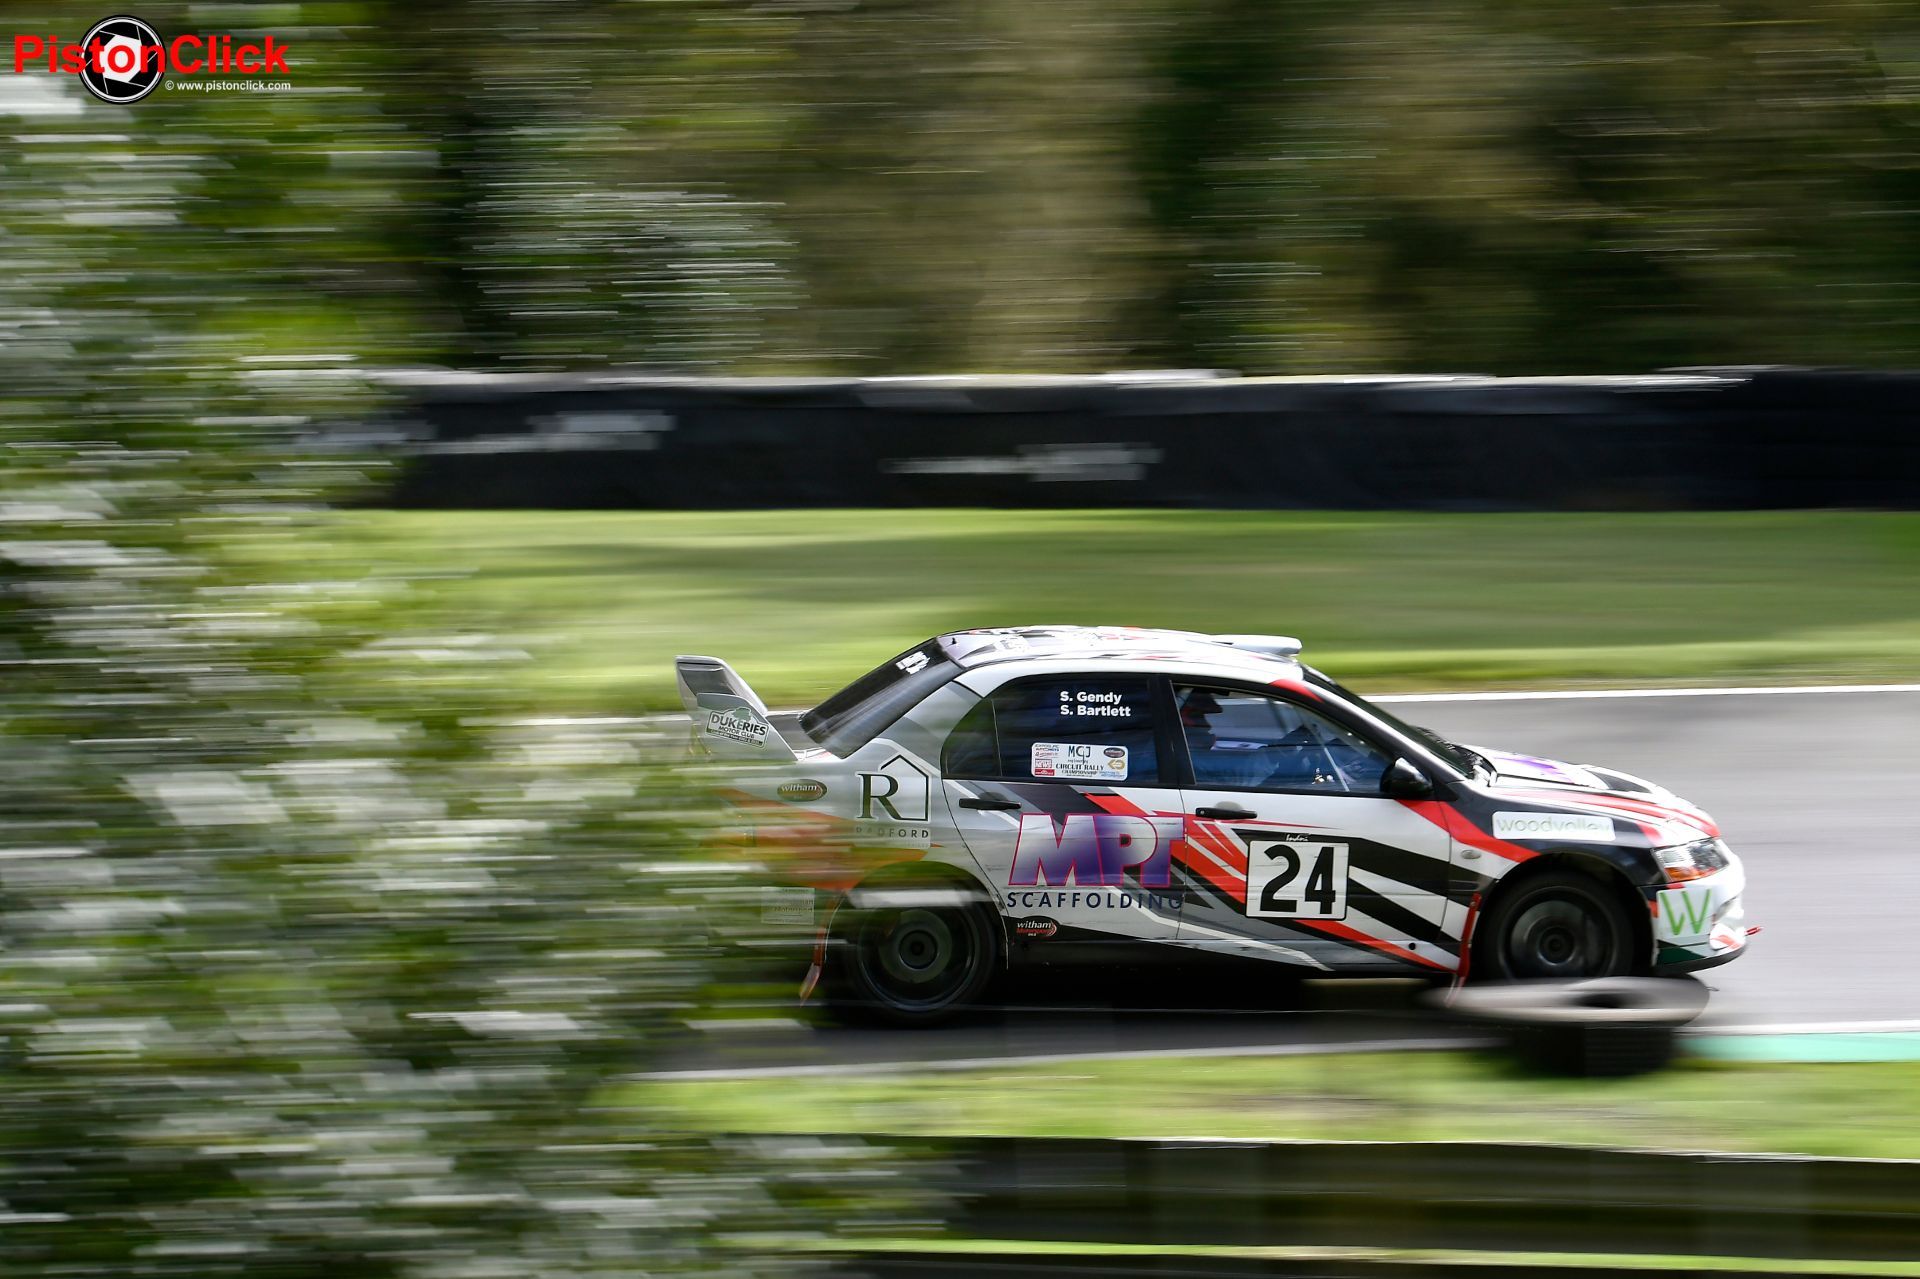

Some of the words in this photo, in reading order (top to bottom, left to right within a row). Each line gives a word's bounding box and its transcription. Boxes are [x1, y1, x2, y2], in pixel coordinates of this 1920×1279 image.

[1060, 690, 1073, 702] S.
[1077, 691, 1122, 705] Gendy
[1060, 704, 1073, 715] S.
[1077, 705, 1131, 717] Bartlett
[711, 714, 766, 736] DUKERIES
[718, 726, 740, 735] MOTOR
[740, 731, 755, 739] CLUB
[781, 783, 818, 792] witham
[1259, 844, 1336, 915] 24
[1006, 891, 1183, 910] SCAFFOLDING
[1016, 920, 1052, 929] witham
